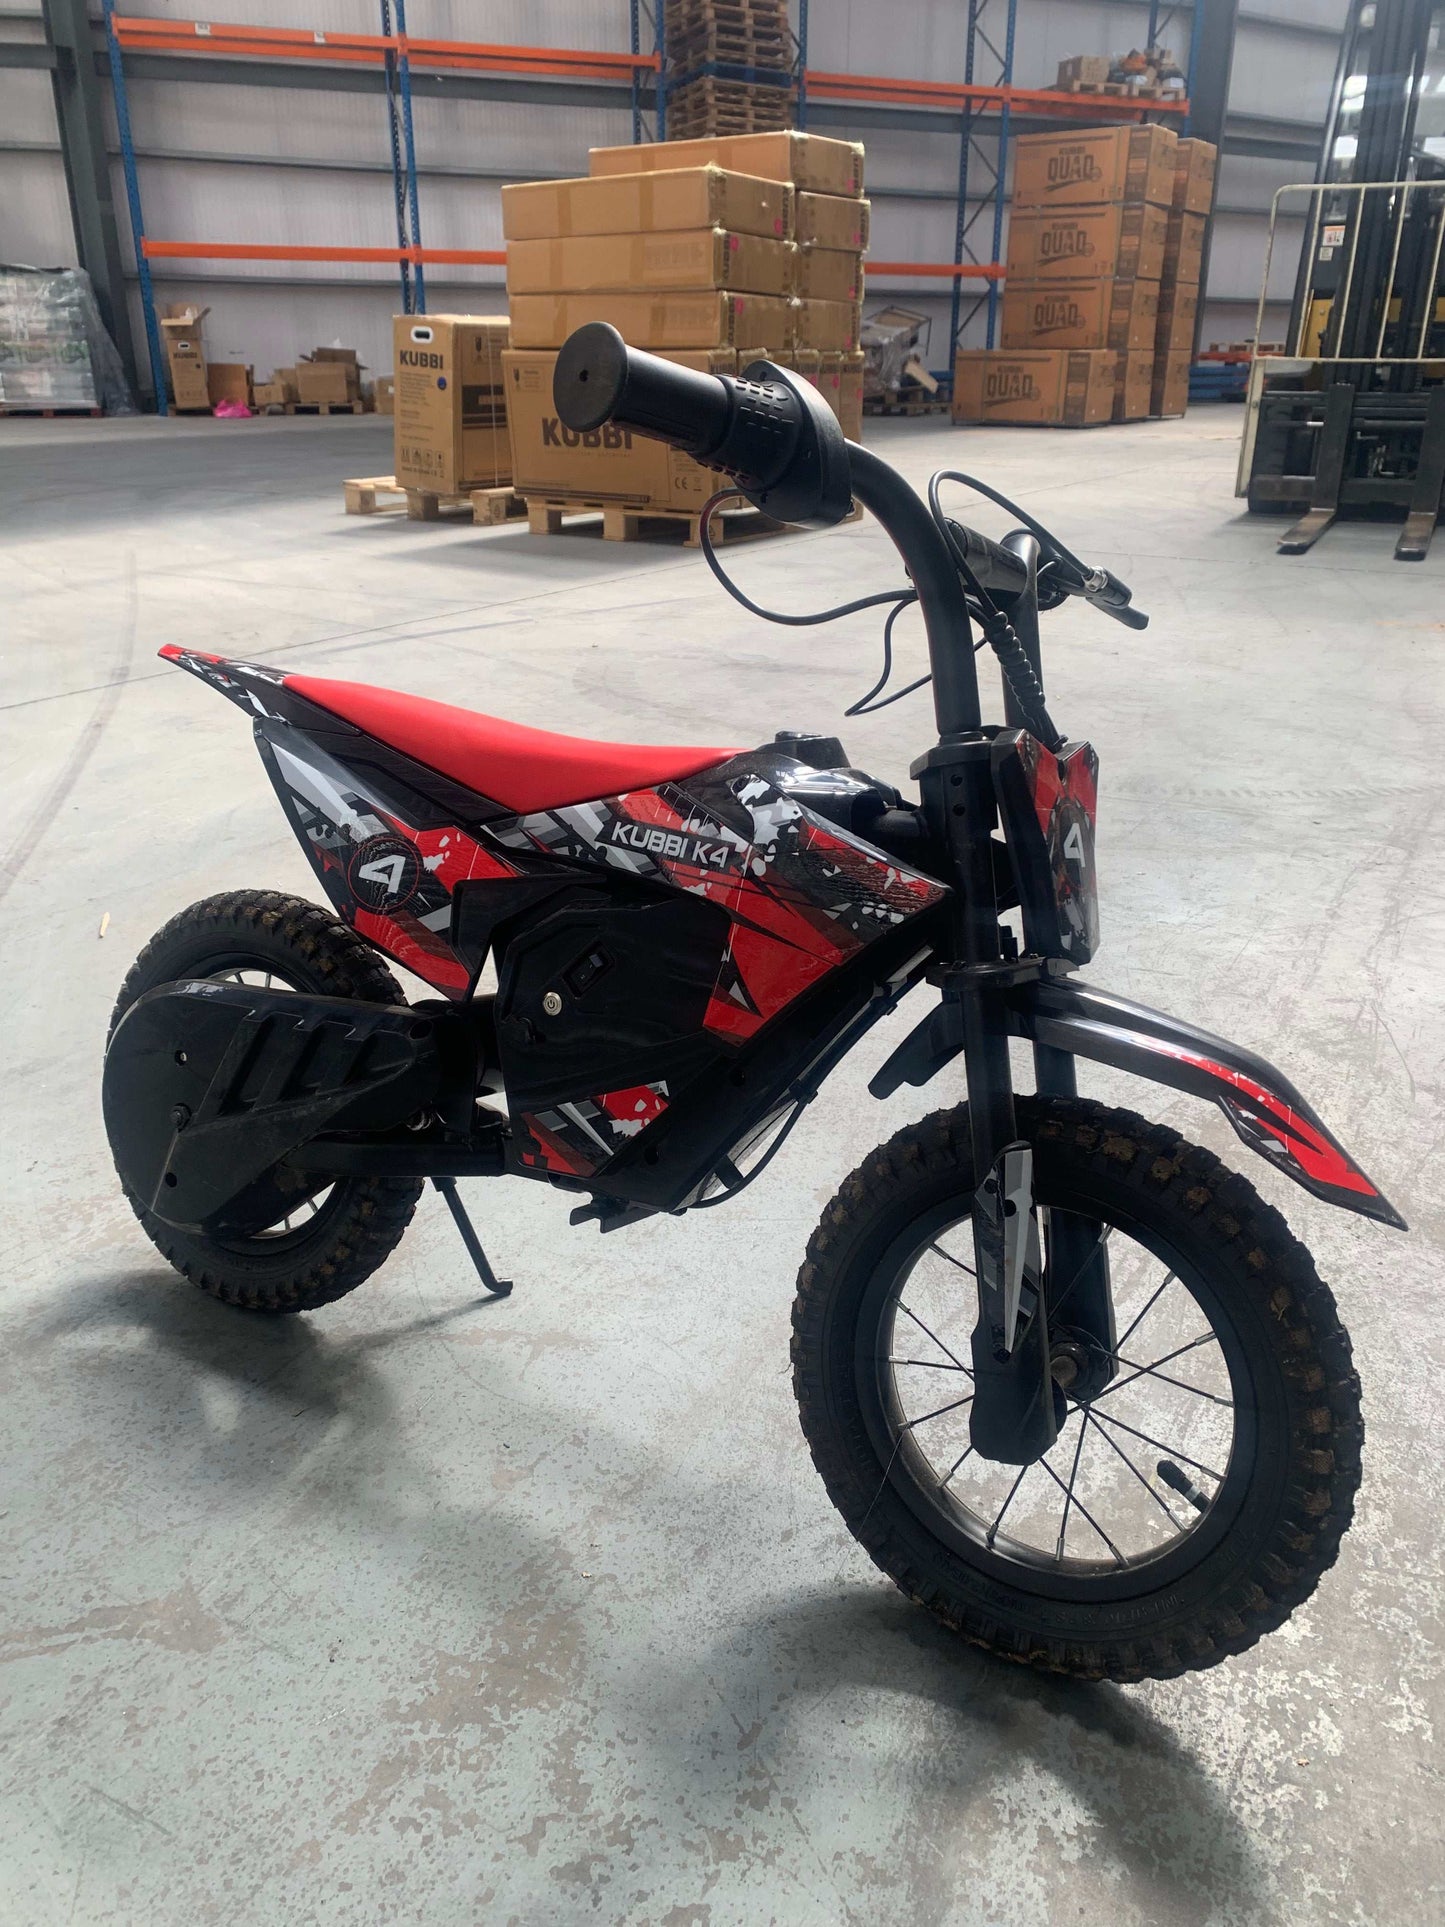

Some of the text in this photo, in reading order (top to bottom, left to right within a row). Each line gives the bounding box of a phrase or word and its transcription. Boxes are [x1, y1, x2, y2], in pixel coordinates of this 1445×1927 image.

[399, 349, 444, 369] KUBBI
[611, 821, 730, 868] KUBBI K4
[1063, 822, 1086, 868] 4
[358, 854, 406, 894] 4
